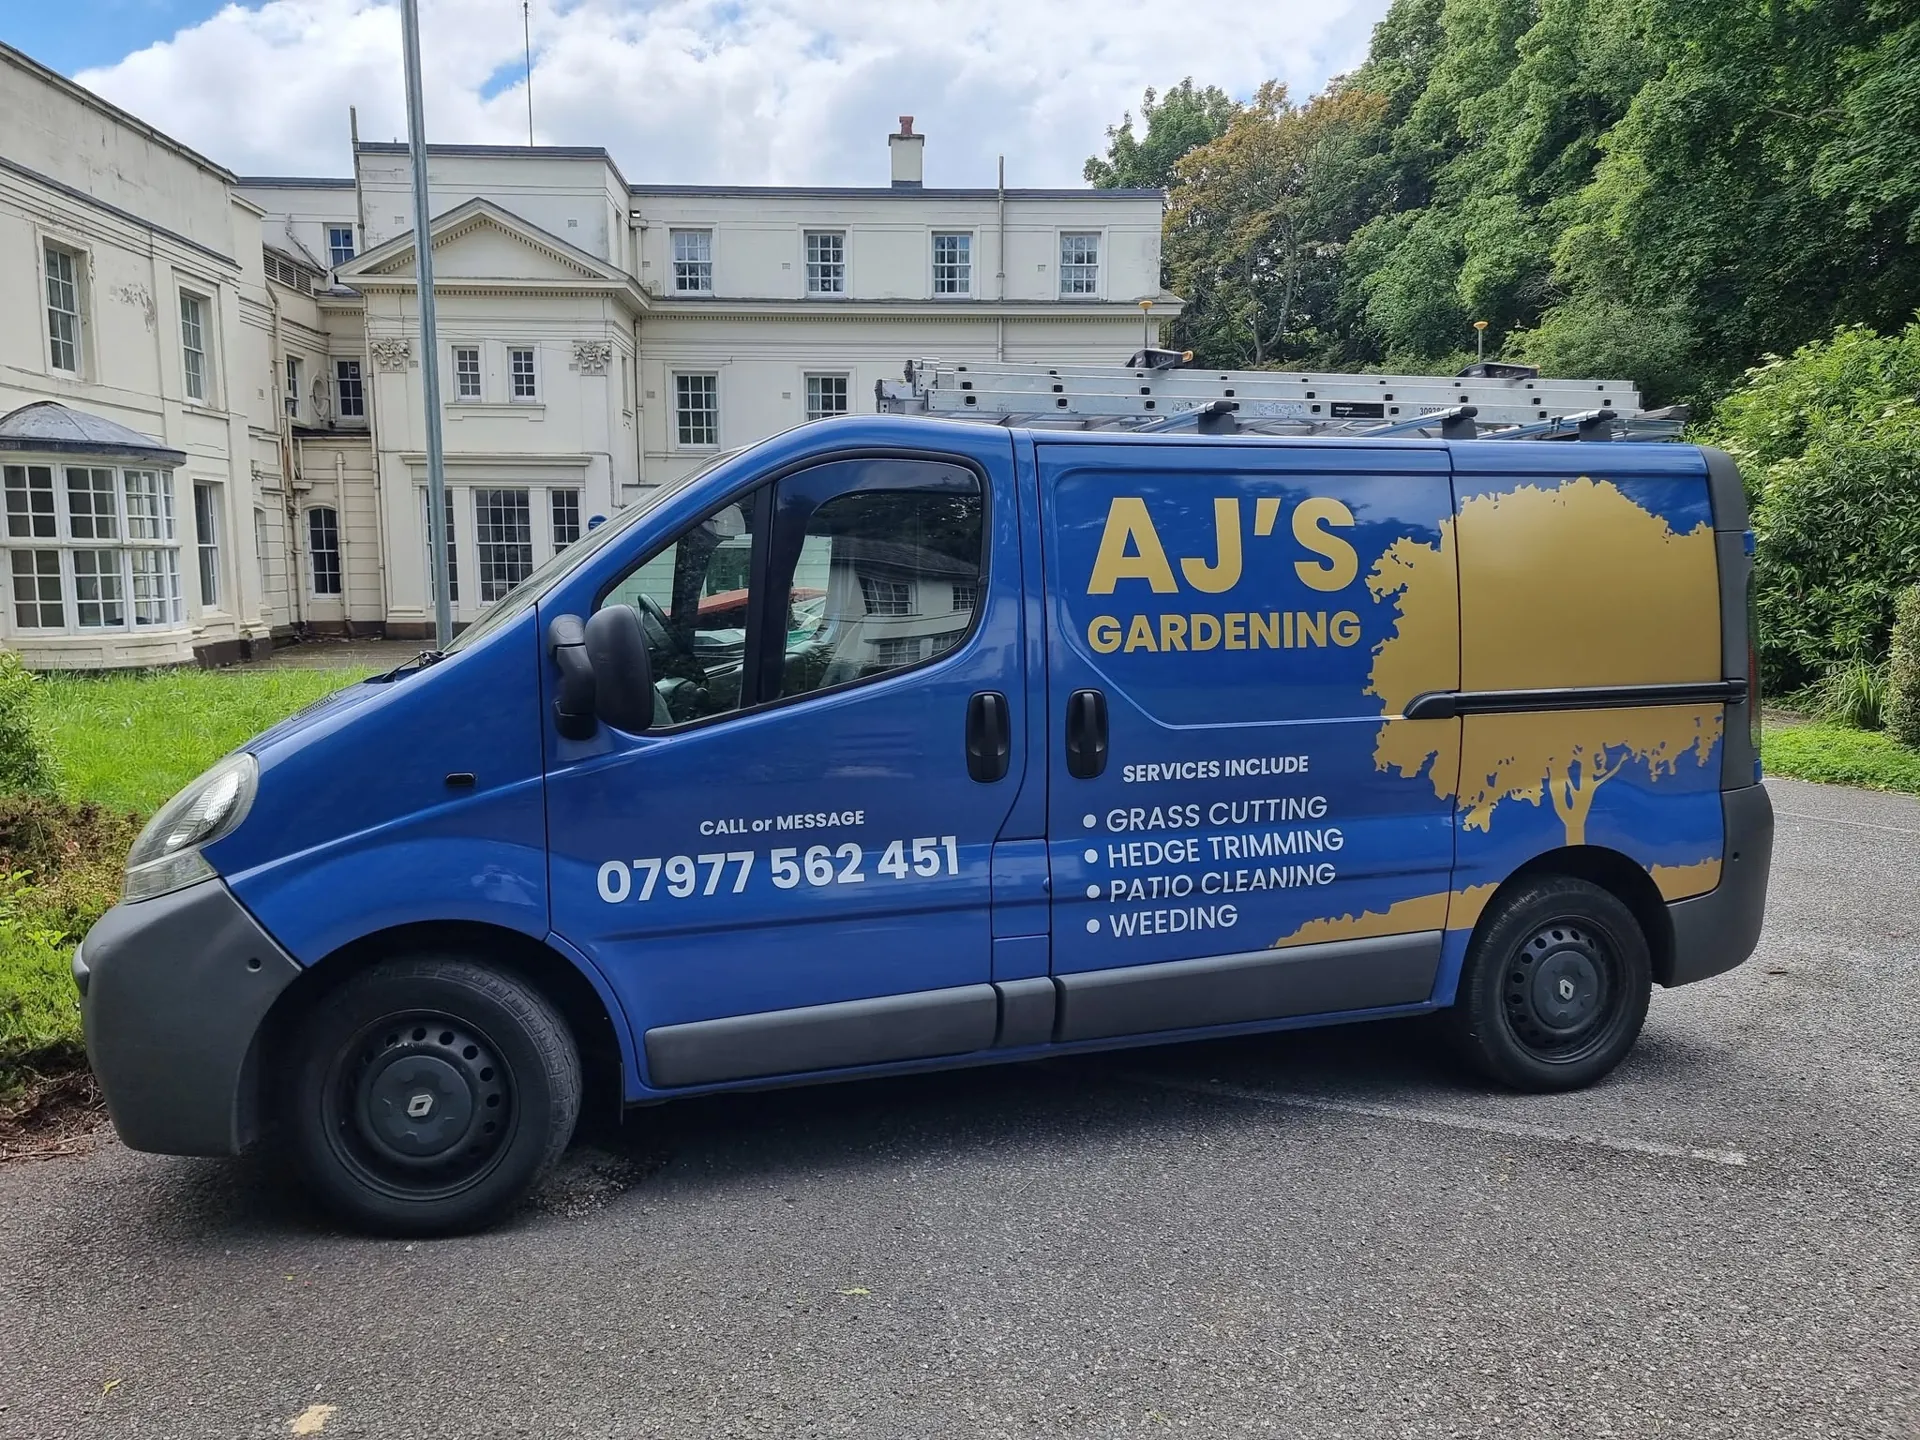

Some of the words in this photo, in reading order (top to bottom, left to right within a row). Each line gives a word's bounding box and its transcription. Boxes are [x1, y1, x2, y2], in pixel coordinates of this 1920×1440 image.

[1086, 496, 1359, 595] AJ'S
[1087, 610, 1361, 654] GARDENING
[1123, 760, 1220, 783] SERVICES
[1225, 755, 1309, 777] INCLUDE
[699, 818, 748, 836] CALL
[751, 819, 773, 832] or
[776, 810, 865, 831] MESSAGE
[1106, 804, 1200, 832] GRASS
[1208, 795, 1328, 825] CUTTING
[1107, 838, 1200, 868] HEDGE
[1207, 828, 1344, 859] TRIMMING
[597, 850, 755, 903] 07977
[770, 842, 865, 889] 562
[877, 835, 959, 880] 451
[1110, 874, 1193, 903] PATIO
[1201, 863, 1336, 895] CLEANING
[1109, 904, 1238, 938] WEEDING
